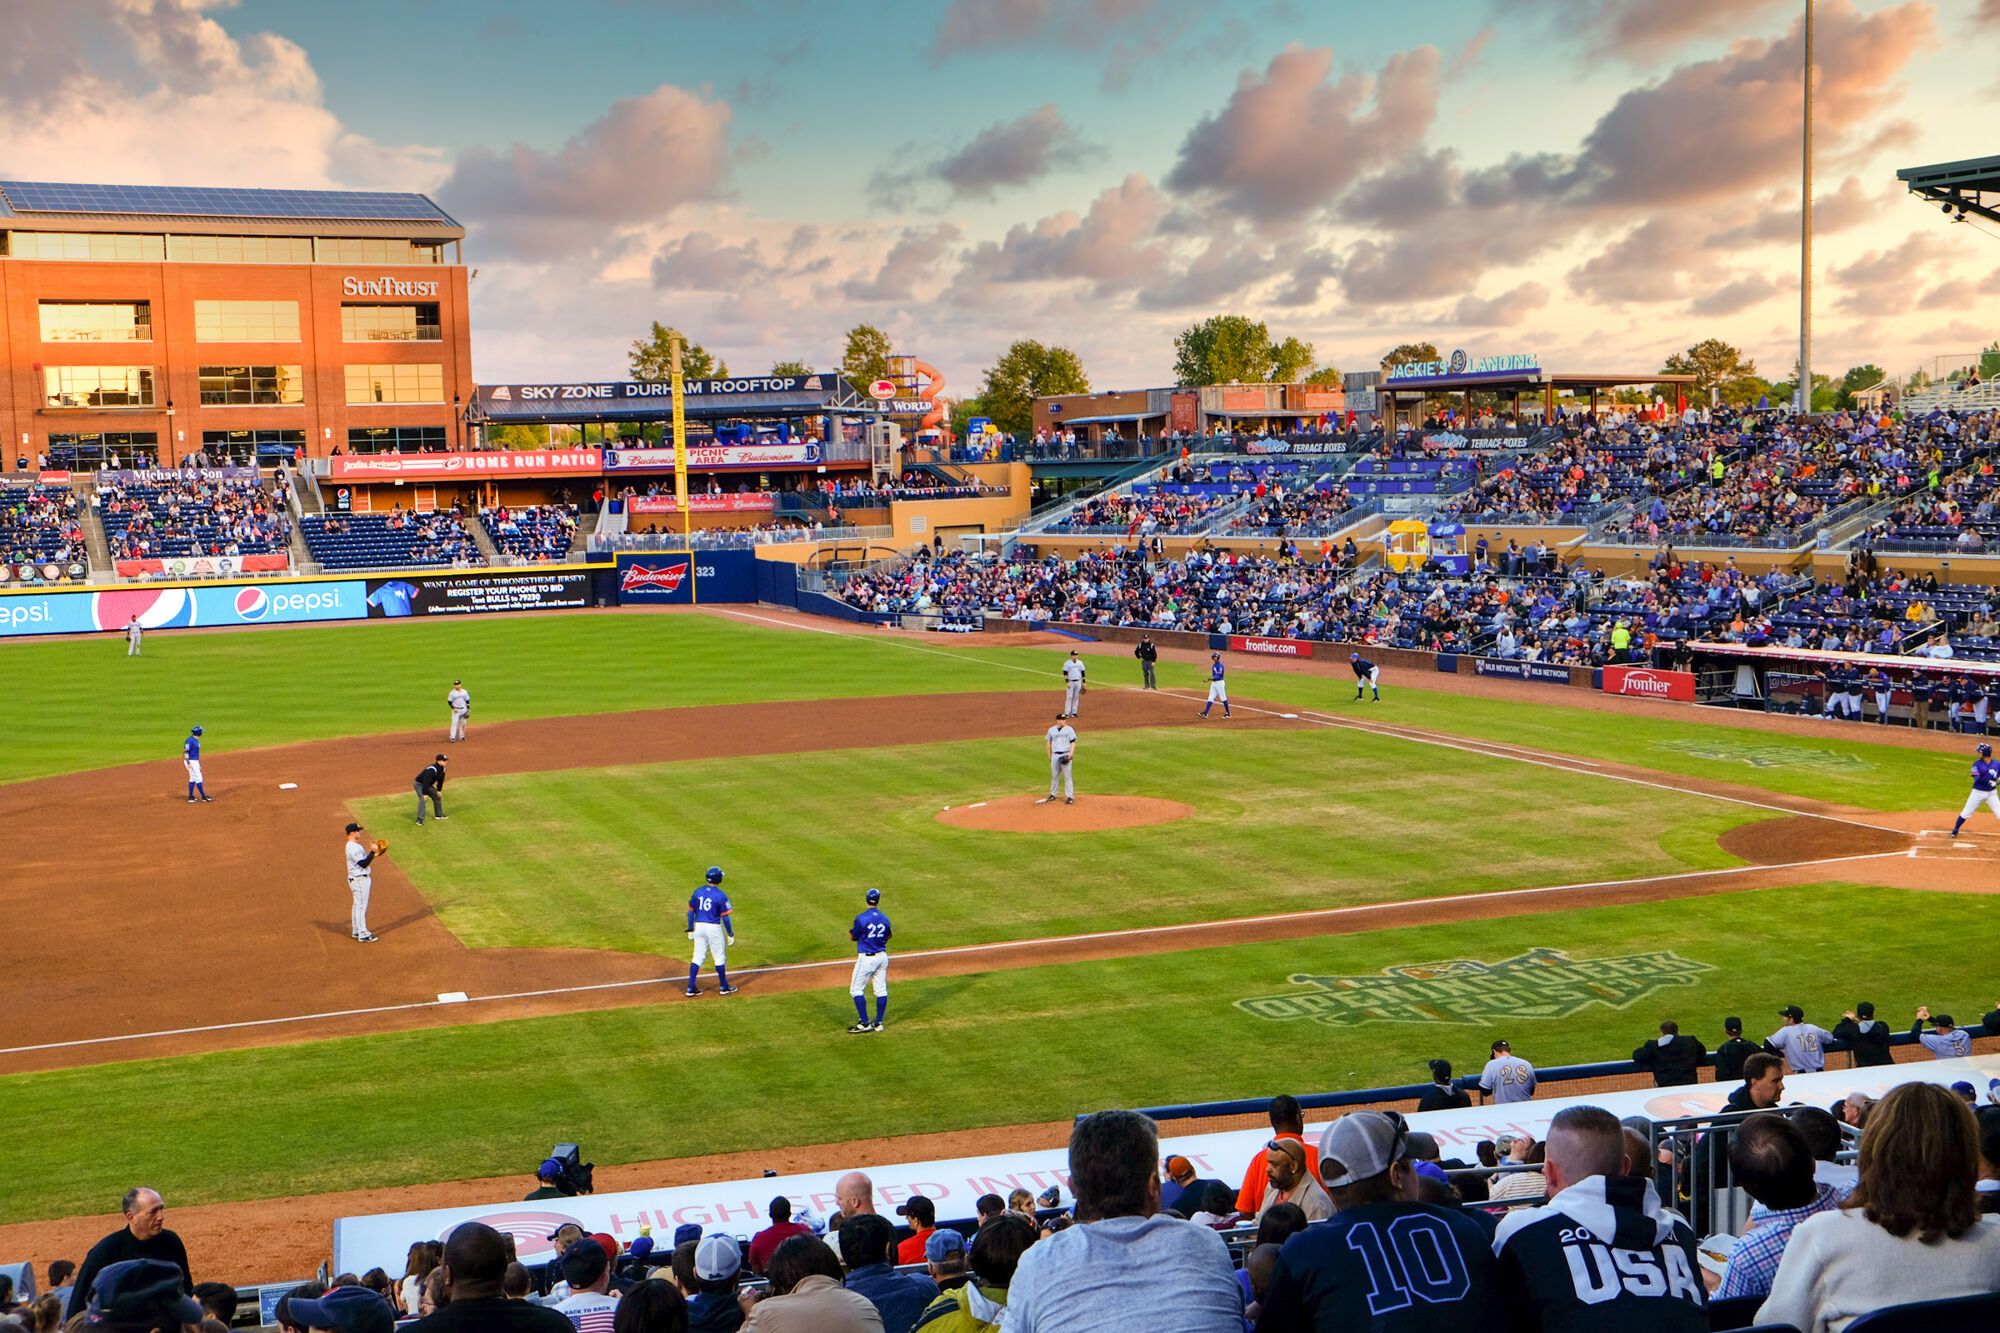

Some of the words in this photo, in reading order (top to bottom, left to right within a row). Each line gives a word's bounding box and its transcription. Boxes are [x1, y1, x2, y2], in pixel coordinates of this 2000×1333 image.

[1389, 360, 1448, 378] JACKIE'S
[1468, 353, 1537, 373] LANDING
[520, 386, 557, 399] SKY
[562, 385, 614, 398] ZONE
[626, 382, 702, 397] DURHAM
[710, 378, 796, 393] ROOFTOP
[892, 401, 932, 412] WORLD
[1268, 444, 1291, 452] LIGHT
[1293, 443, 1323, 453] TERRACE
[1323, 442, 1347, 452] BOXES
[1444, 439, 1468, 448] LIGHT
[1471, 438, 1501, 448] TERRACE
[690, 449, 729, 457] PICNIC
[695, 456, 724, 464] AREA
[737, 453, 794, 463] Budweiser
[465, 456, 509, 469] HOME
[514, 455, 546, 468] RUN
[551, 454, 596, 467] PATIO
[627, 456, 676, 466] Budweise
[133, 468, 182, 481] Michael
[185, 468, 198, 480] &
[201, 468, 223, 480] Son
[620, 569, 686, 584] Budweiser
[696, 566, 715, 577] 323
[448, 580, 454, 588] A
[455, 580, 478, 588] GAME
[557, 574, 586, 583] JERSEY?
[447, 588, 484, 598] REGISTER
[485, 587, 508, 595] YOUR
[509, 585, 538, 594] PHONE
[538, 584, 549, 592] TO
[550, 584, 564, 592] BID
[486, 594, 510, 603] BULLS
[273, 588, 339, 615] pepsi
[1245, 638, 1297, 654] frontier.com
[1485, 663, 1496, 671] MLB
[1496, 664, 1520, 673] NETWORK
[1532, 667, 1542, 675] MLB
[1543, 669, 1569, 678] NETWORK
[1620, 671, 1672, 693] frontier
[698, 896, 712, 911] 16
[867, 923, 886, 938] 22
[1249, 972, 1522, 1016] OPENING
[1506, 955, 1700, 986] WEEK
[1445, 984, 1590, 1015] 2015
[1796, 1033, 1818, 1052] 12
[1952, 1041, 1966, 1057] 5
[1500, 1065, 1529, 1085] 28
[1345, 1212, 1471, 1316] 10
[1562, 1243, 1703, 1306] USA
